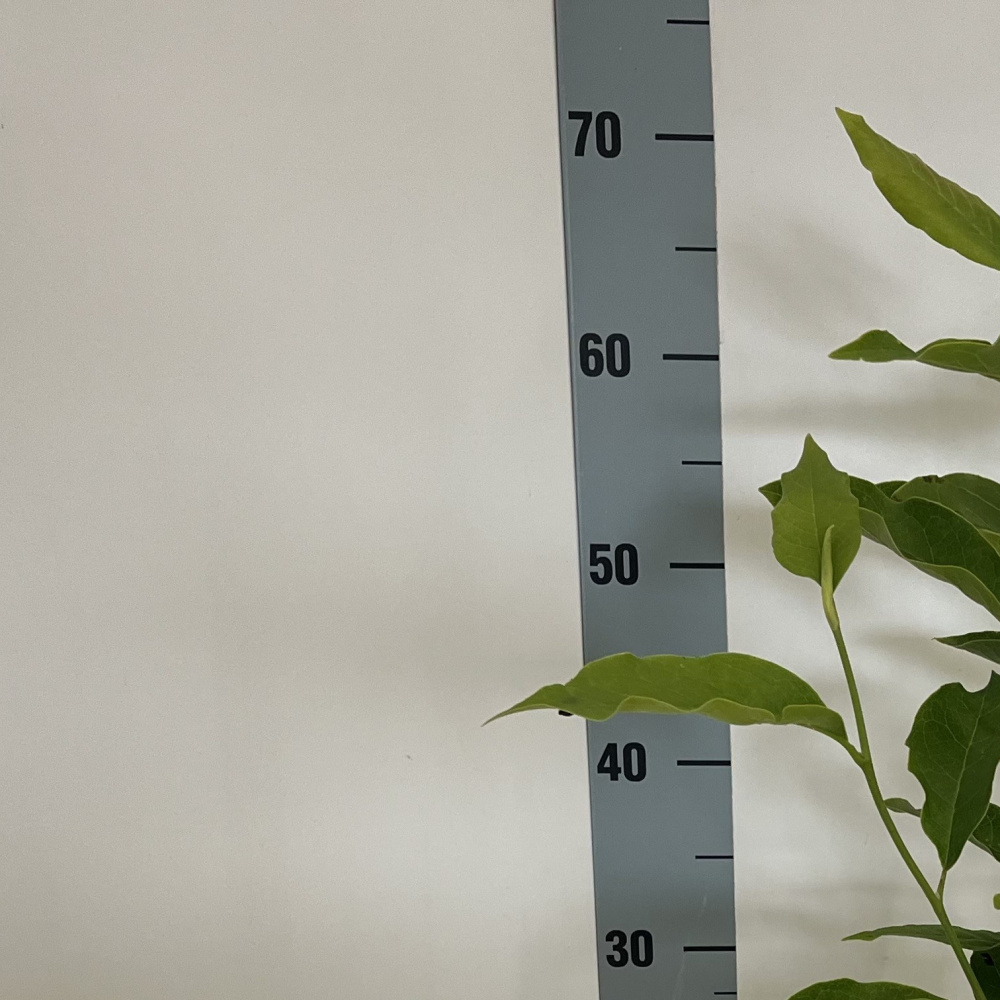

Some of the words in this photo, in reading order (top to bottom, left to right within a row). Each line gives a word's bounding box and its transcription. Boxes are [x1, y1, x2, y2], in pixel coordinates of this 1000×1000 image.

[568, 111, 622, 158] 70
[579, 333, 631, 377] 60
[589, 543, 639, 585] 50
[597, 742, 647, 782] 40
[605, 930, 654, 967] 30
